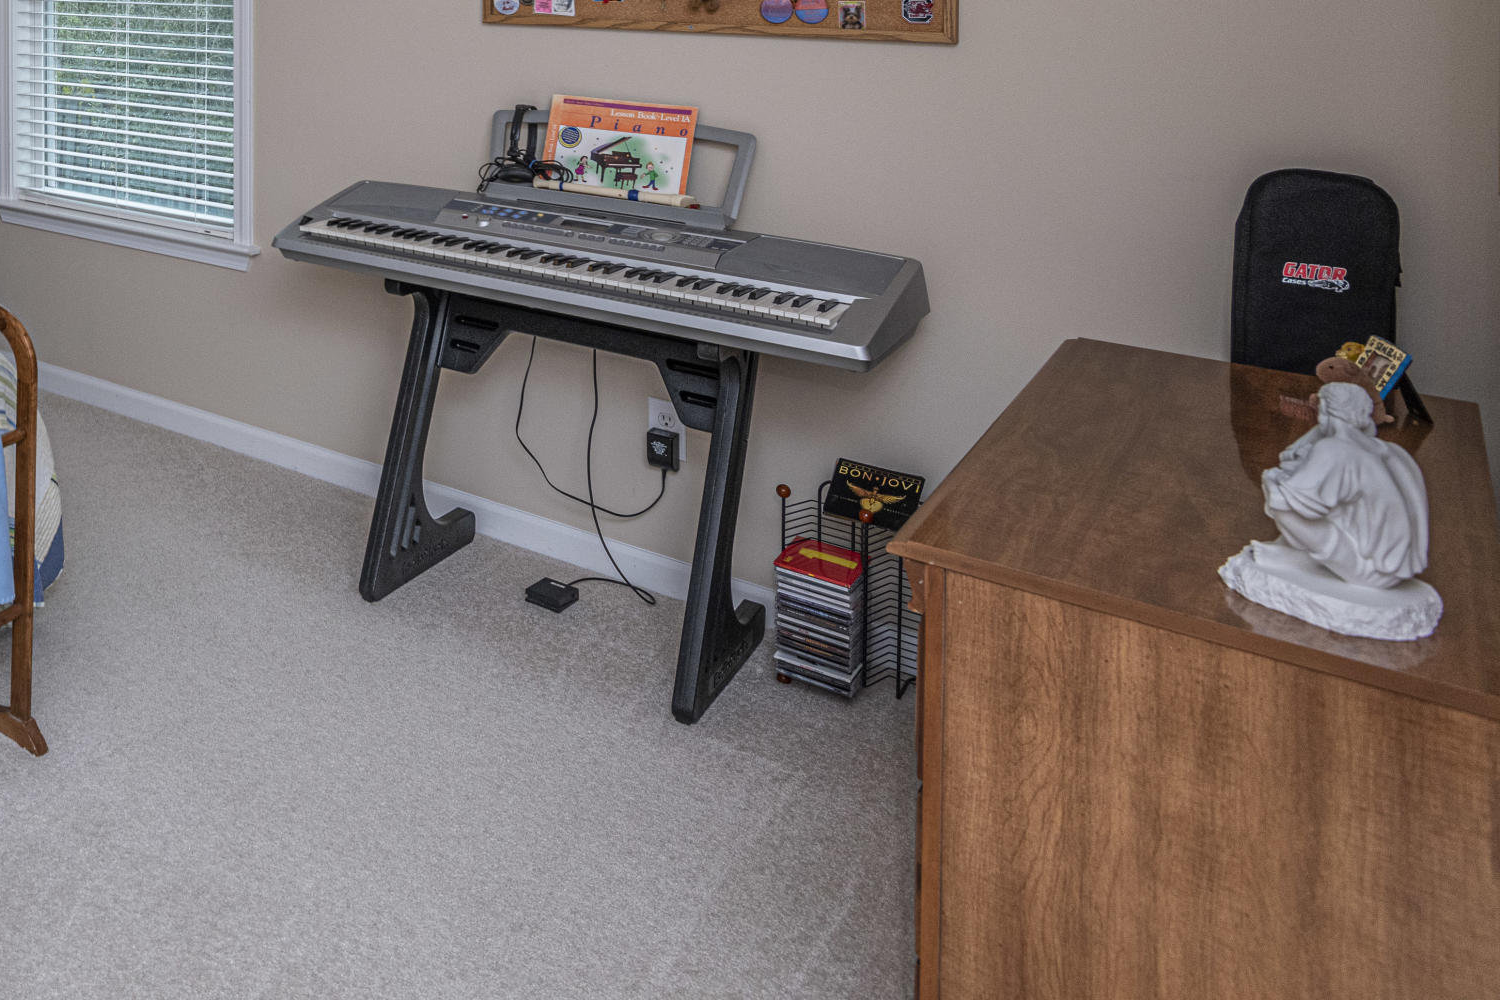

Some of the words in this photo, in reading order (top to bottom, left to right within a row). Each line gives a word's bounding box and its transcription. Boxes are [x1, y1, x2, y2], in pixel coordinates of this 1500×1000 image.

[589, 115, 689, 137] Piano
[610, 109, 635, 118] Lesson
[637, 111, 655, 120] Book
[660, 114, 680, 122] Level
[681, 115, 691, 123] 1A
[1283, 262, 1347, 280] GATOR
[839, 465, 873, 481] BON
[881, 477, 920, 493] JOVI
